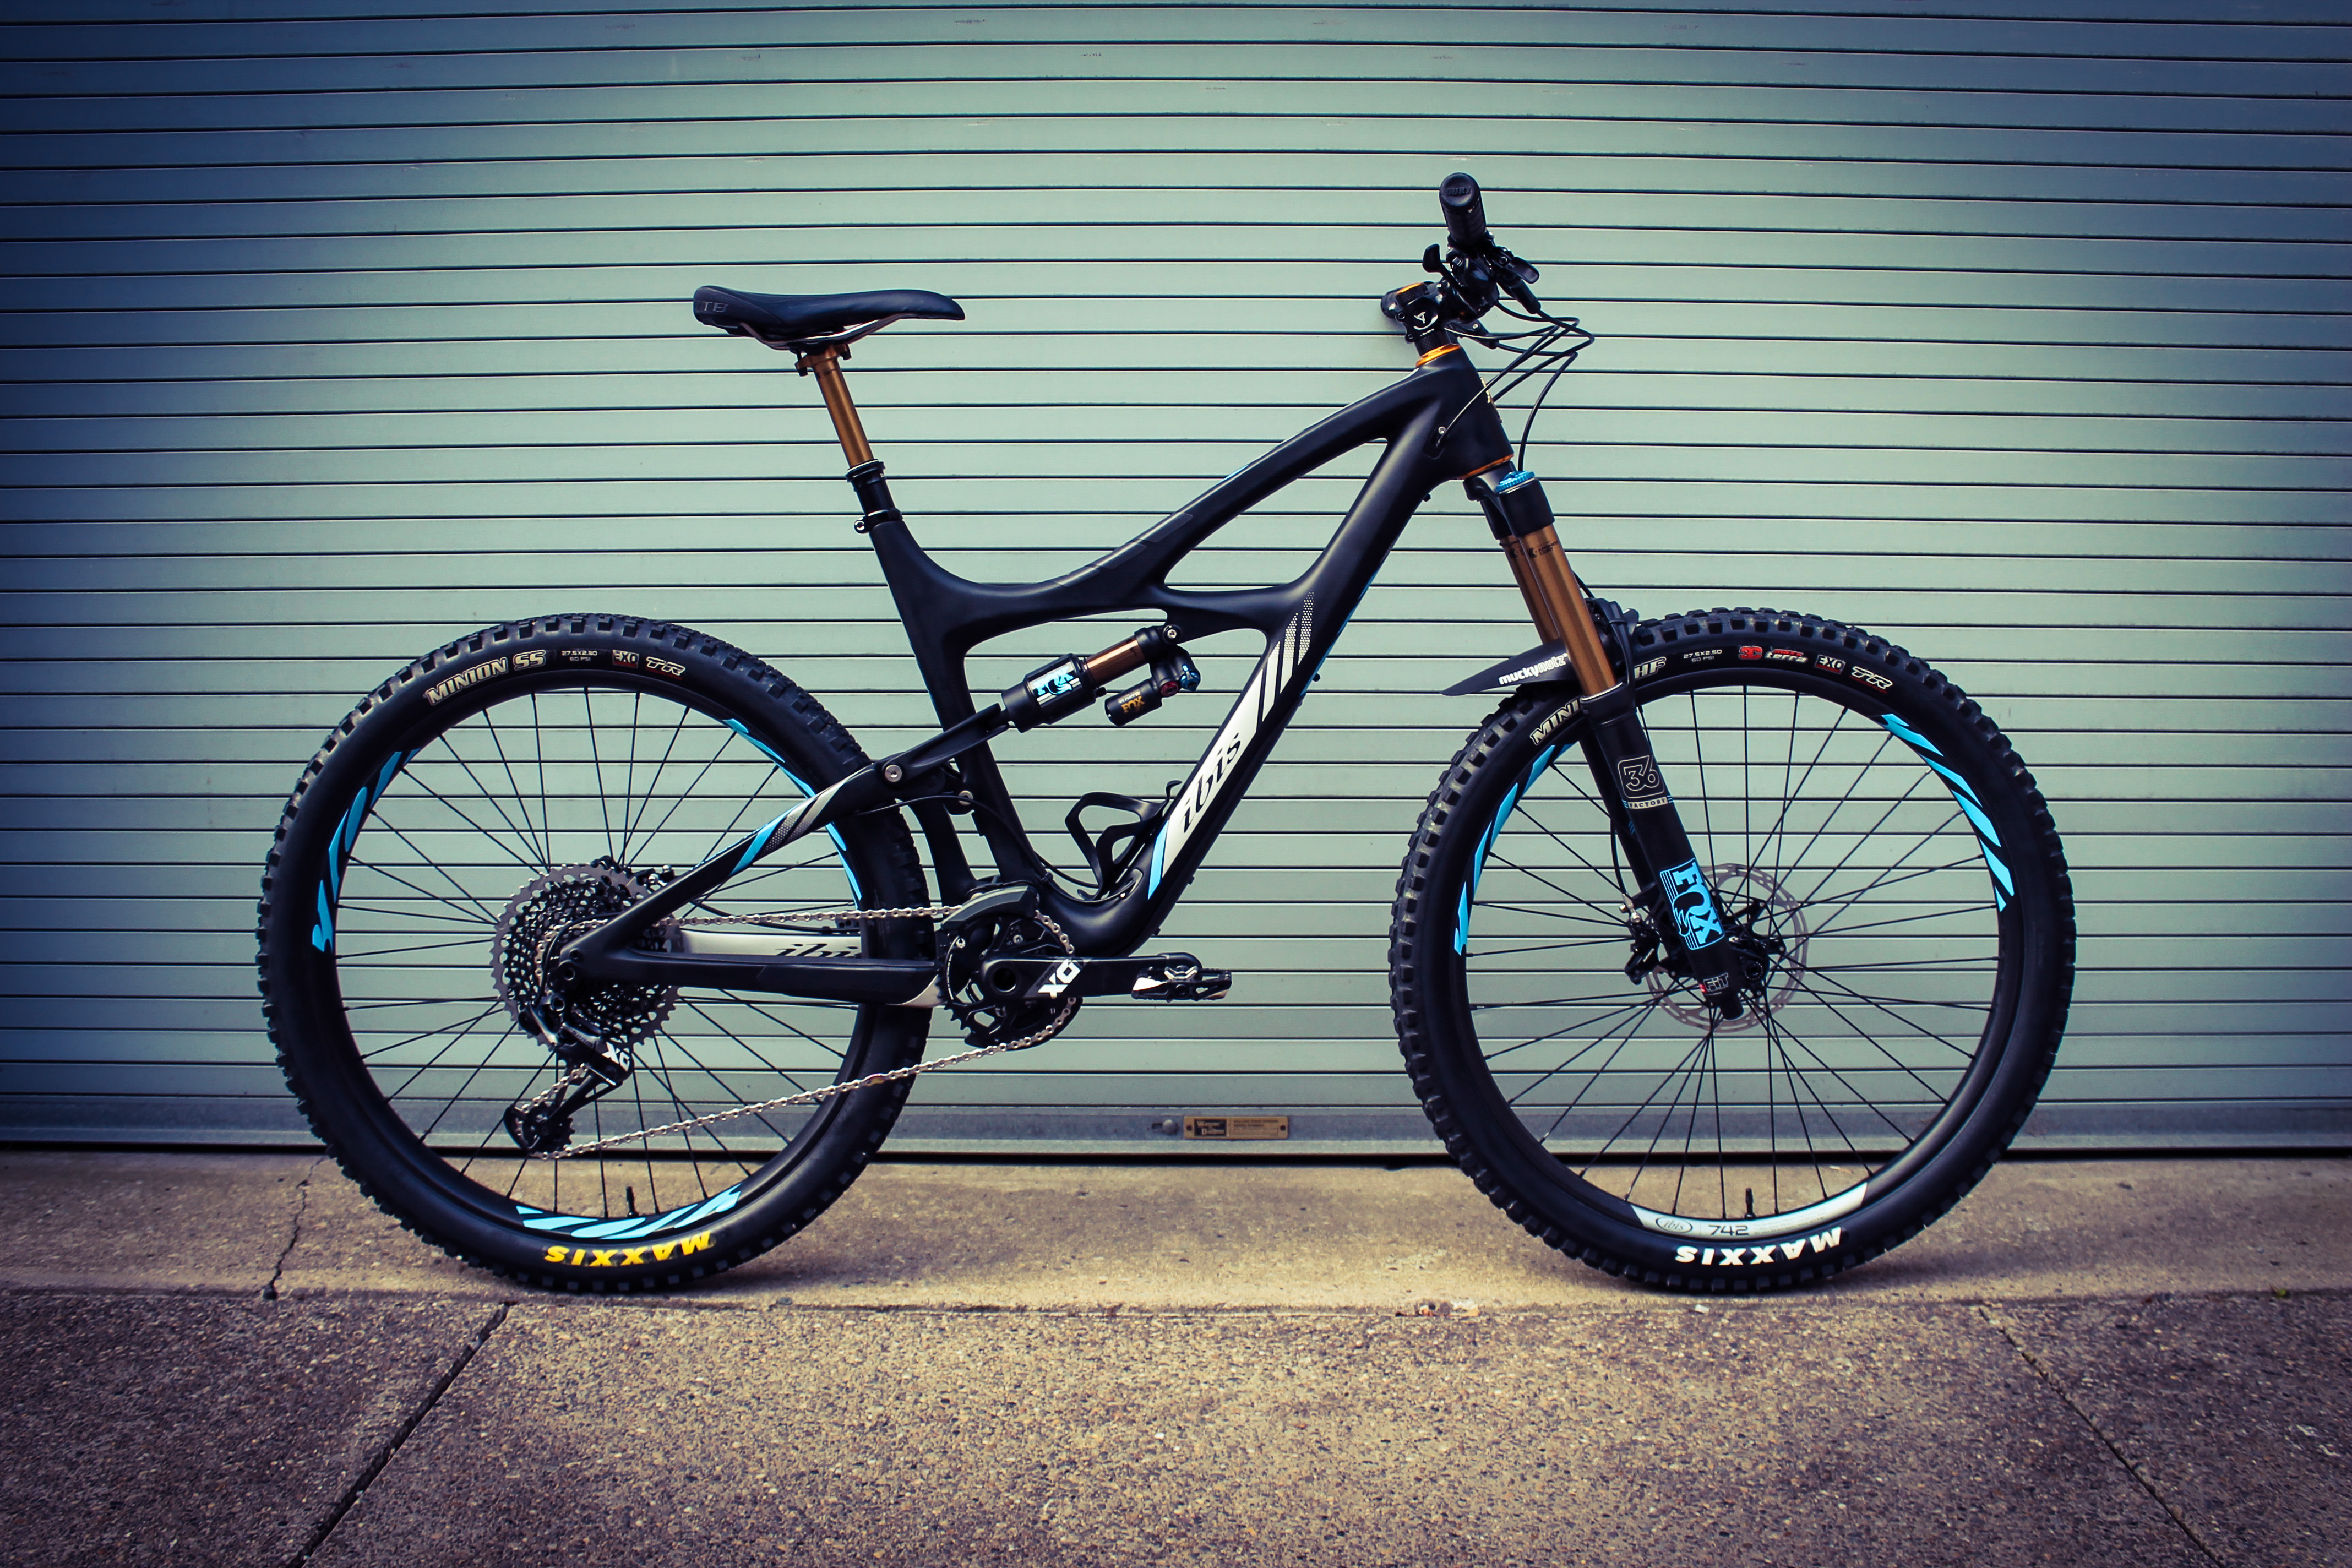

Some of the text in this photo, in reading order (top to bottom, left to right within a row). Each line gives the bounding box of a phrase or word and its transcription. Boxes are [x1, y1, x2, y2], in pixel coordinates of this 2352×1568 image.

[613, 650, 639, 665] EXO
[1738, 646, 1763, 660] 3C
[1817, 655, 1844, 671] EXO
[424, 650, 546, 705] MINION SS
[646, 656, 685, 676] TR
[1851, 666, 1893, 690] TR
[1033, 666, 1074, 696] FOX
[1121, 696, 1145, 713] FOX
[1530, 697, 1581, 745] MINI
[1623, 755, 1660, 791] 36
[1628, 797, 1668, 808] FACTORY
[1673, 861, 1723, 945] FOX
[1708, 1224, 1750, 1236] 742
[544, 1231, 711, 1266] MAXXIS
[1675, 1227, 1842, 1266] MAXXIS
